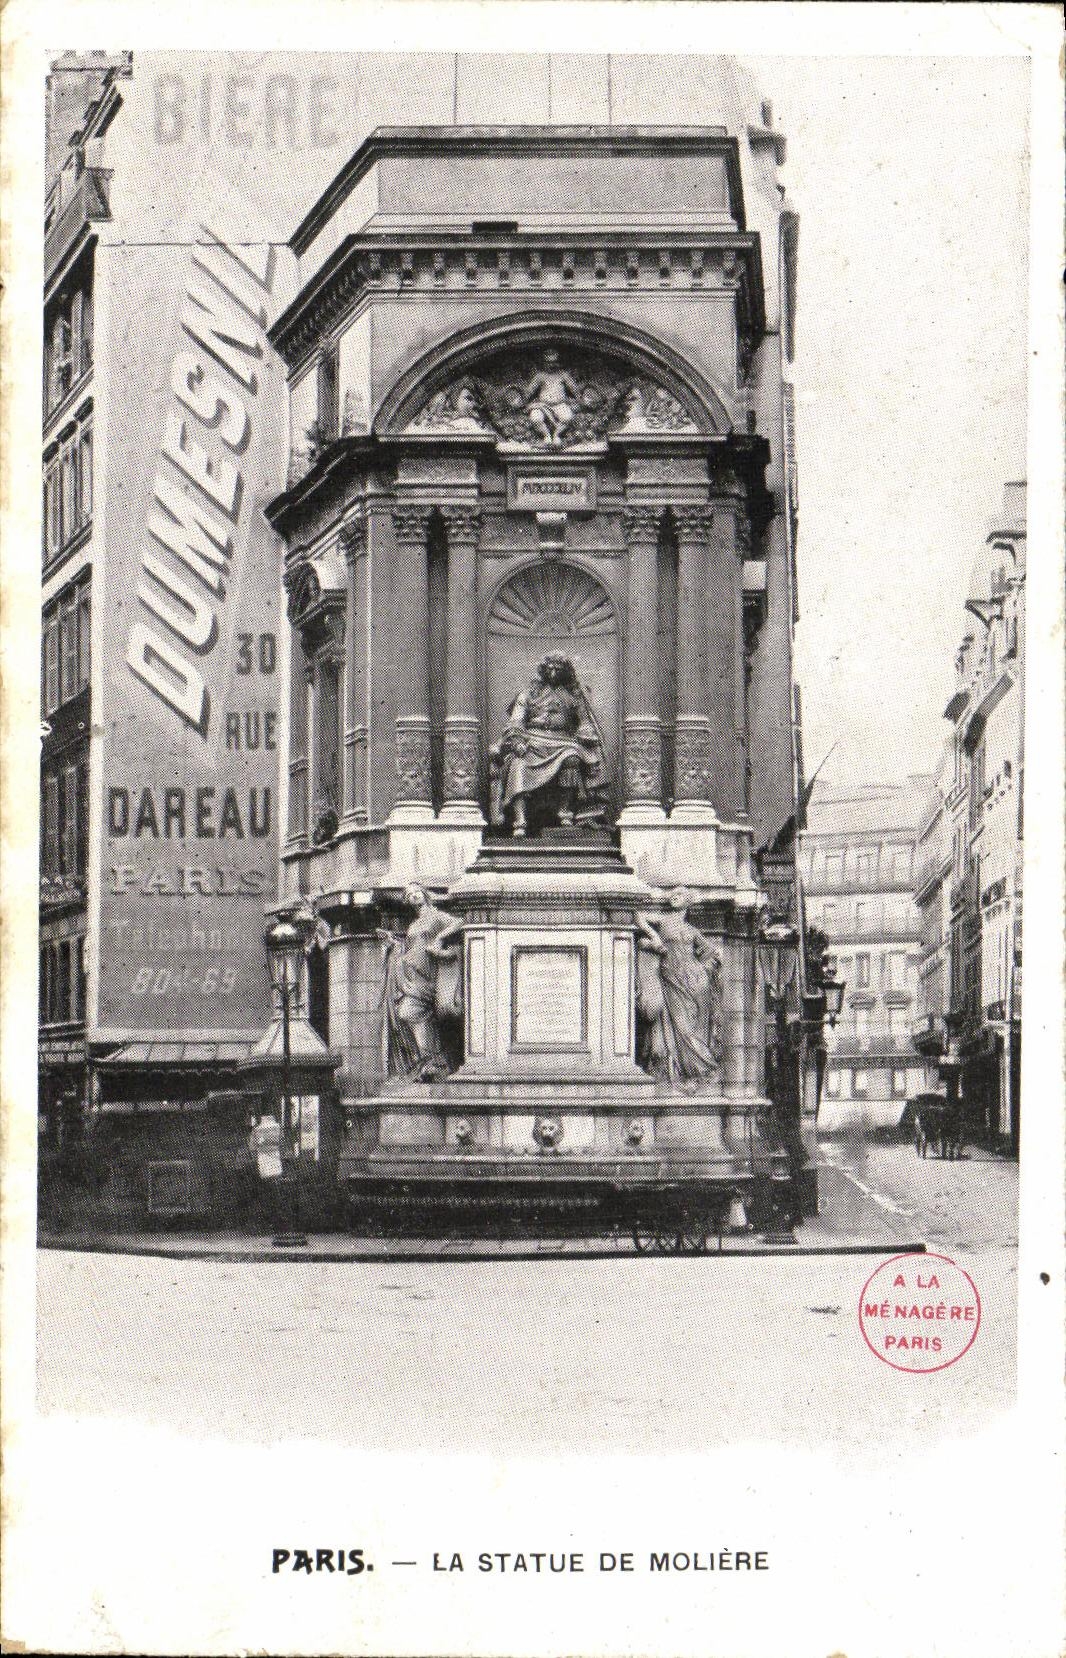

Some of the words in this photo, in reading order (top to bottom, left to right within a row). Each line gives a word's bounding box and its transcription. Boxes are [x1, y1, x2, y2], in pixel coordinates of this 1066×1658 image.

[126, 220, 276, 741] DUMESNIL
[236, 633, 277, 676] 30
[226, 711, 277, 751] RUE
[108, 787, 271, 838] DAREAU
[109, 864, 273, 898] PARIS
